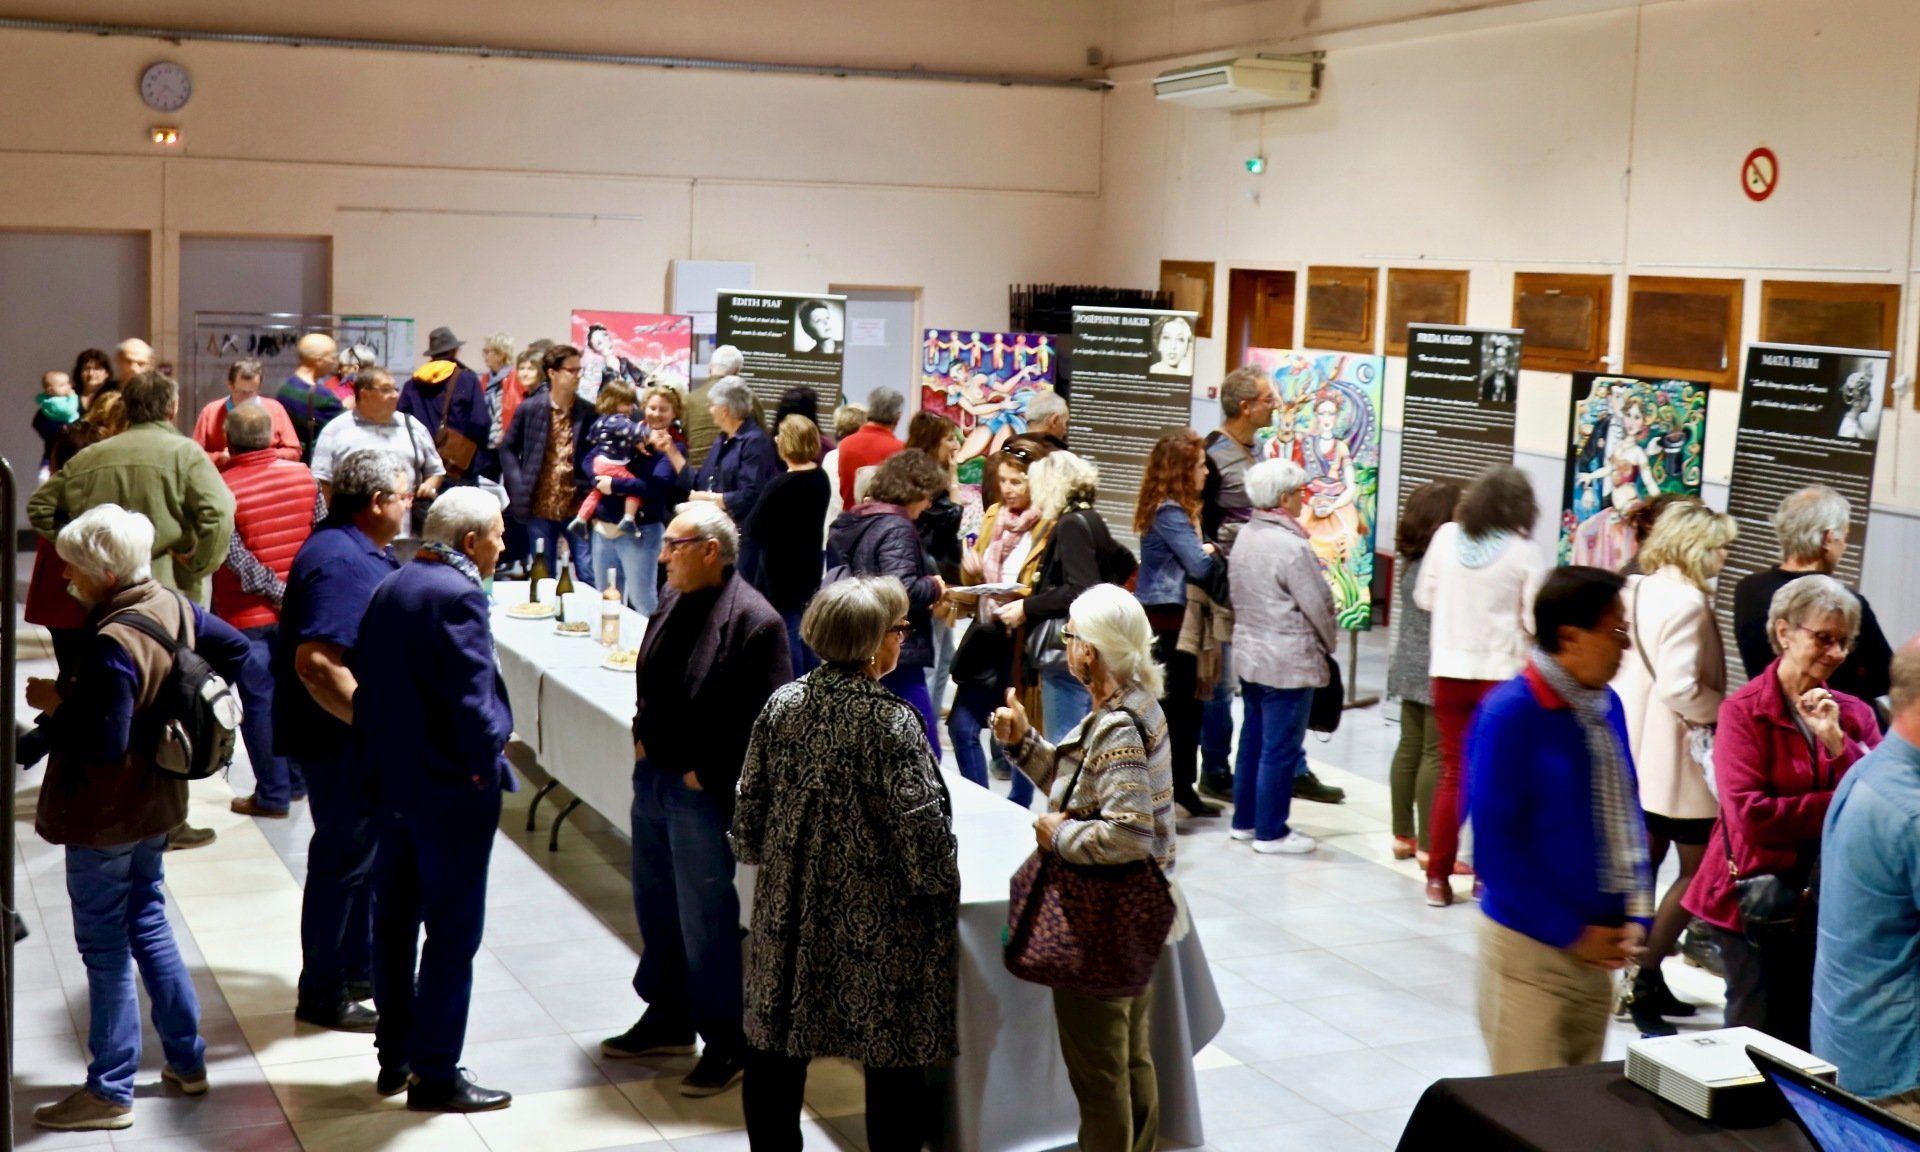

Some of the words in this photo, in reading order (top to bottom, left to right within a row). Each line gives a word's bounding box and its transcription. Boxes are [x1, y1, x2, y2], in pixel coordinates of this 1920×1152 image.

[762, 299, 783, 308] PIAF
[1122, 317, 1150, 327] BAKER
[1761, 354, 1790, 367] MATA
[1792, 356, 1820, 369] HARI
